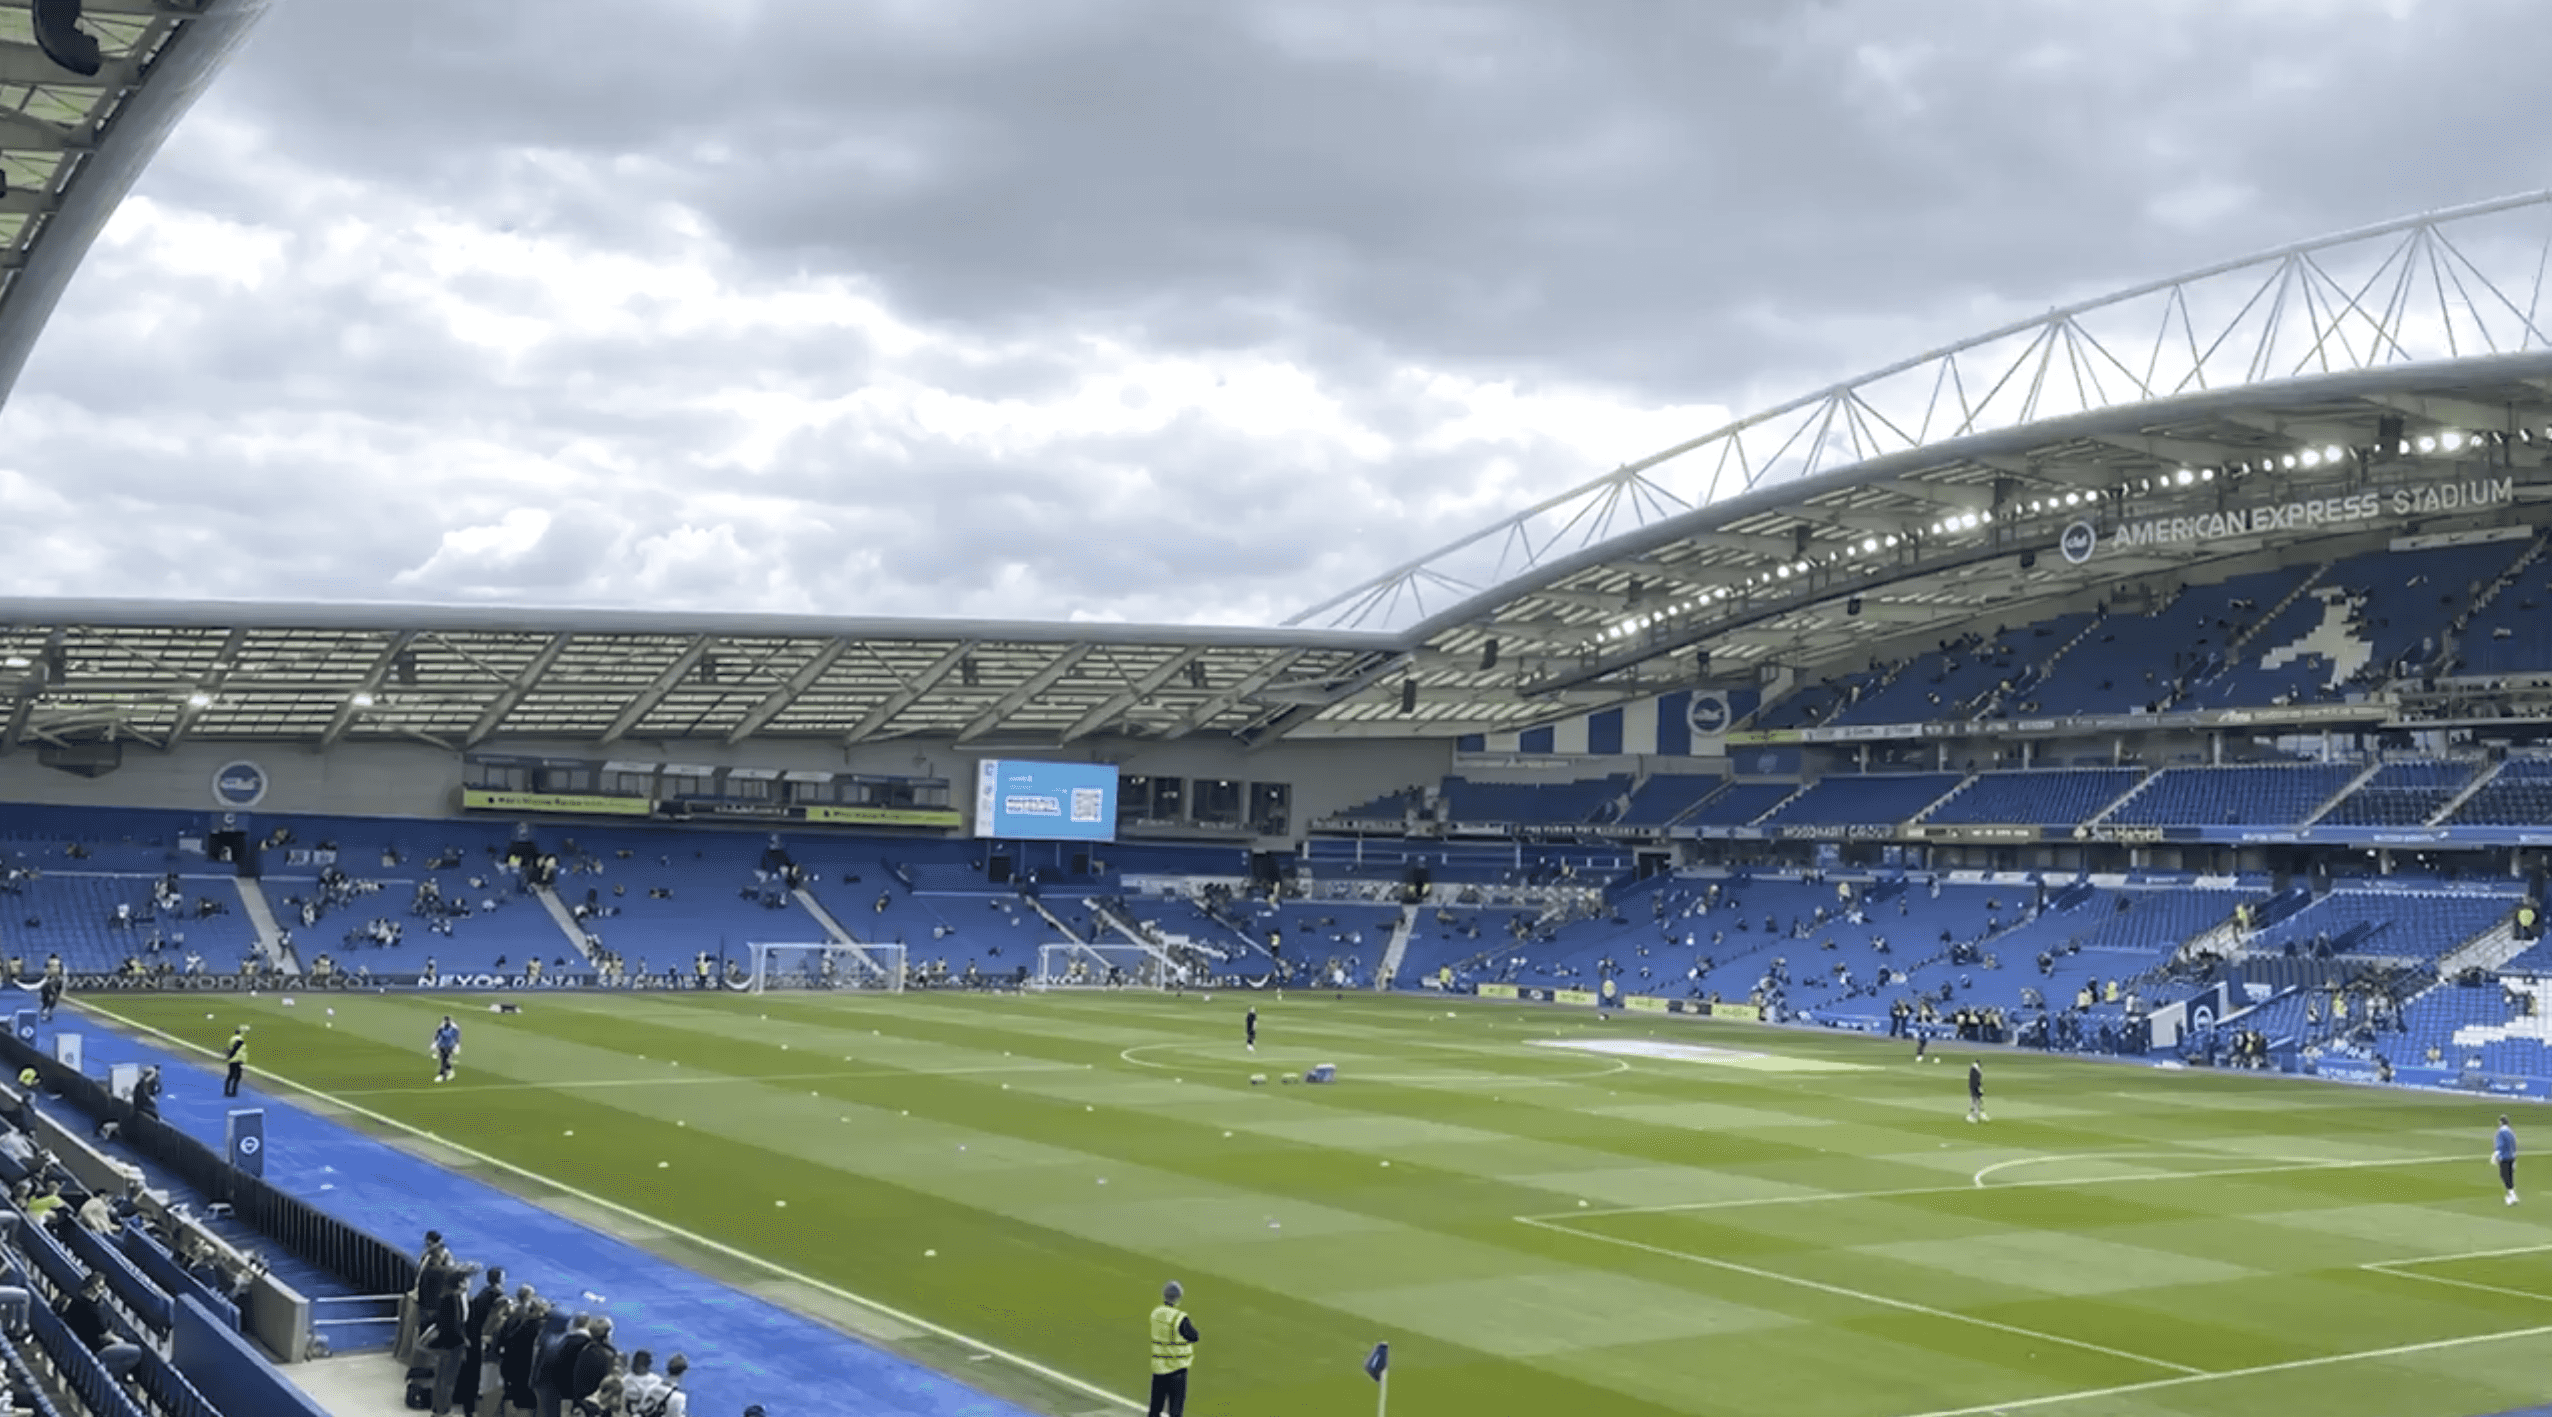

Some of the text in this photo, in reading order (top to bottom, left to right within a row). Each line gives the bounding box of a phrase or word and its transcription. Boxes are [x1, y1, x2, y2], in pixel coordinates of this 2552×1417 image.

[2113, 476, 2513, 548] AMERICAN EXPRESS STADIUM
